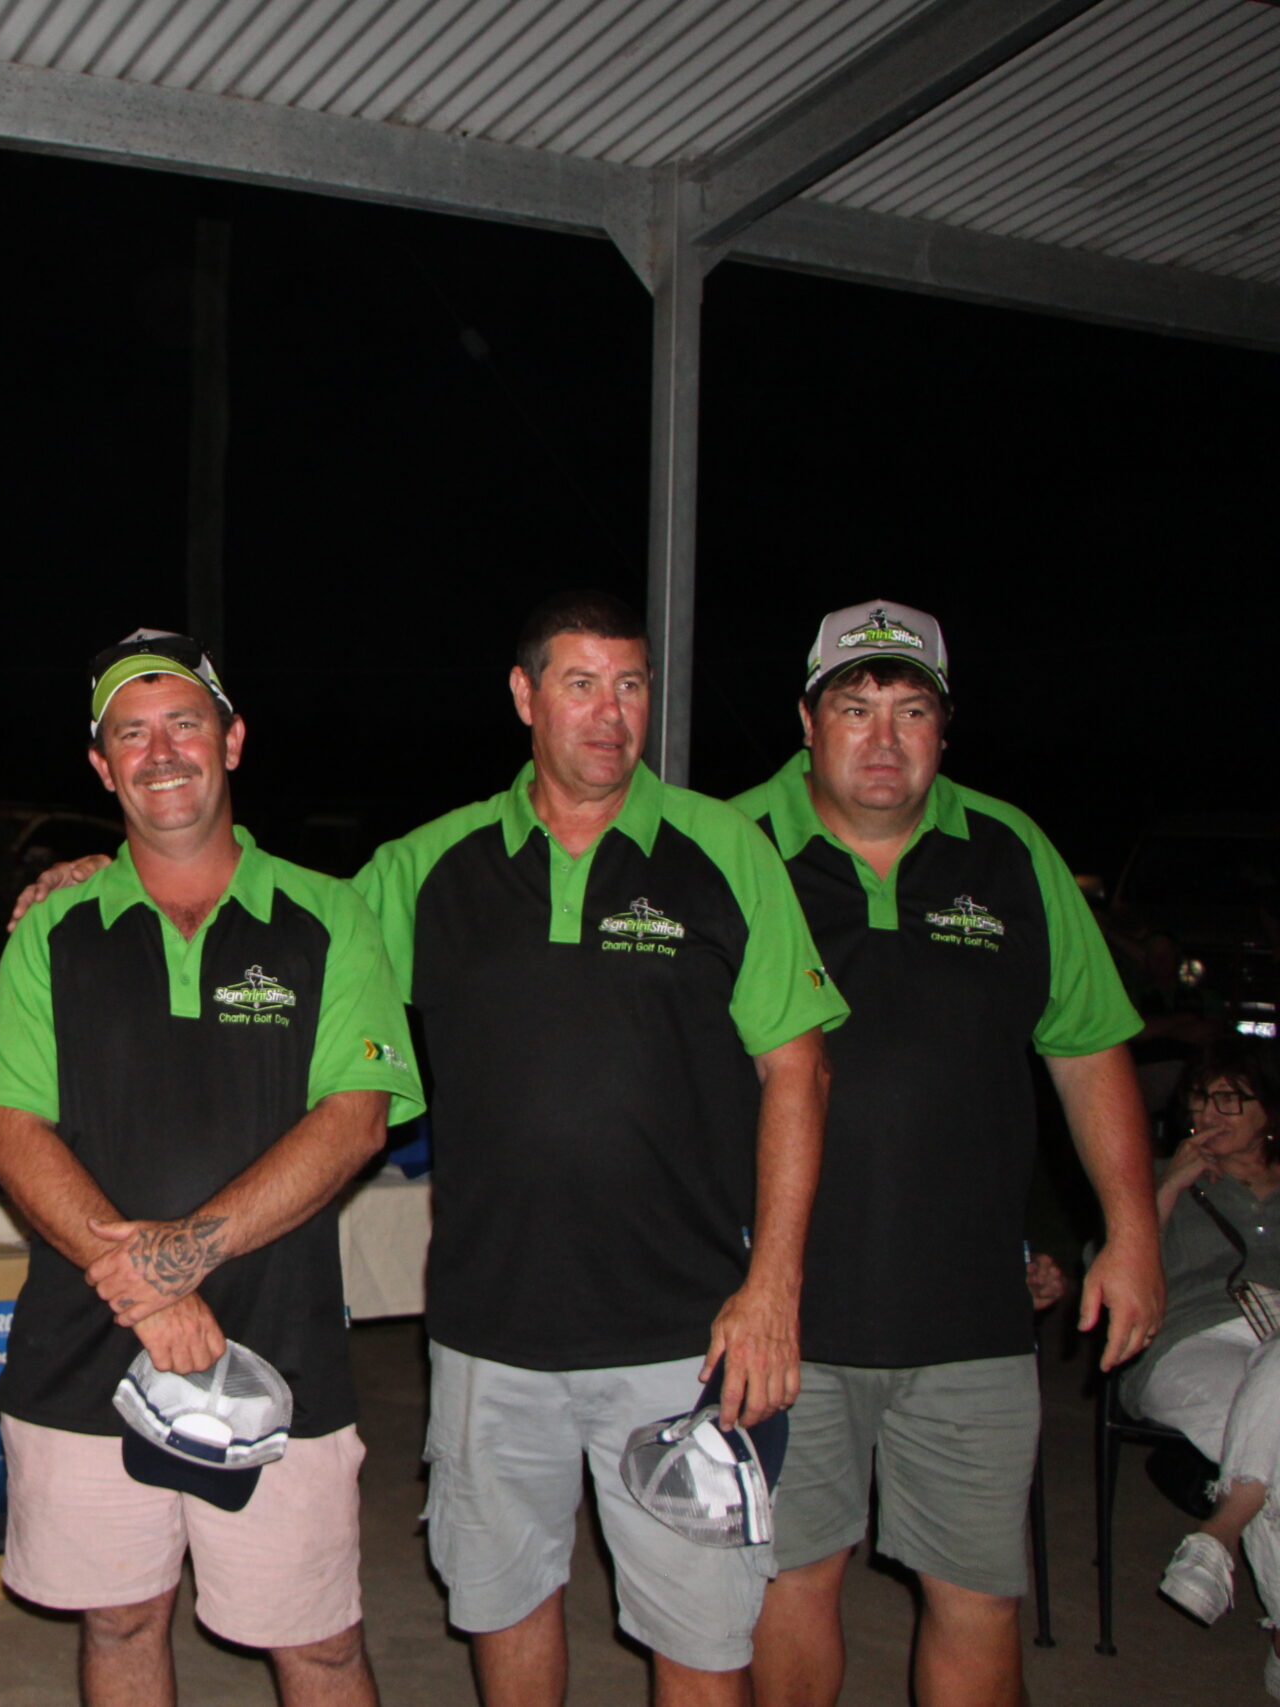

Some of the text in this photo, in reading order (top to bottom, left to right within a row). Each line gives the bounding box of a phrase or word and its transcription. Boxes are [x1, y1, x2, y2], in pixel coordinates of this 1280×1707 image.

[601, 940, 678, 957] Charity Golf Day
[218, 1012, 291, 1028] Charity Golf Day
